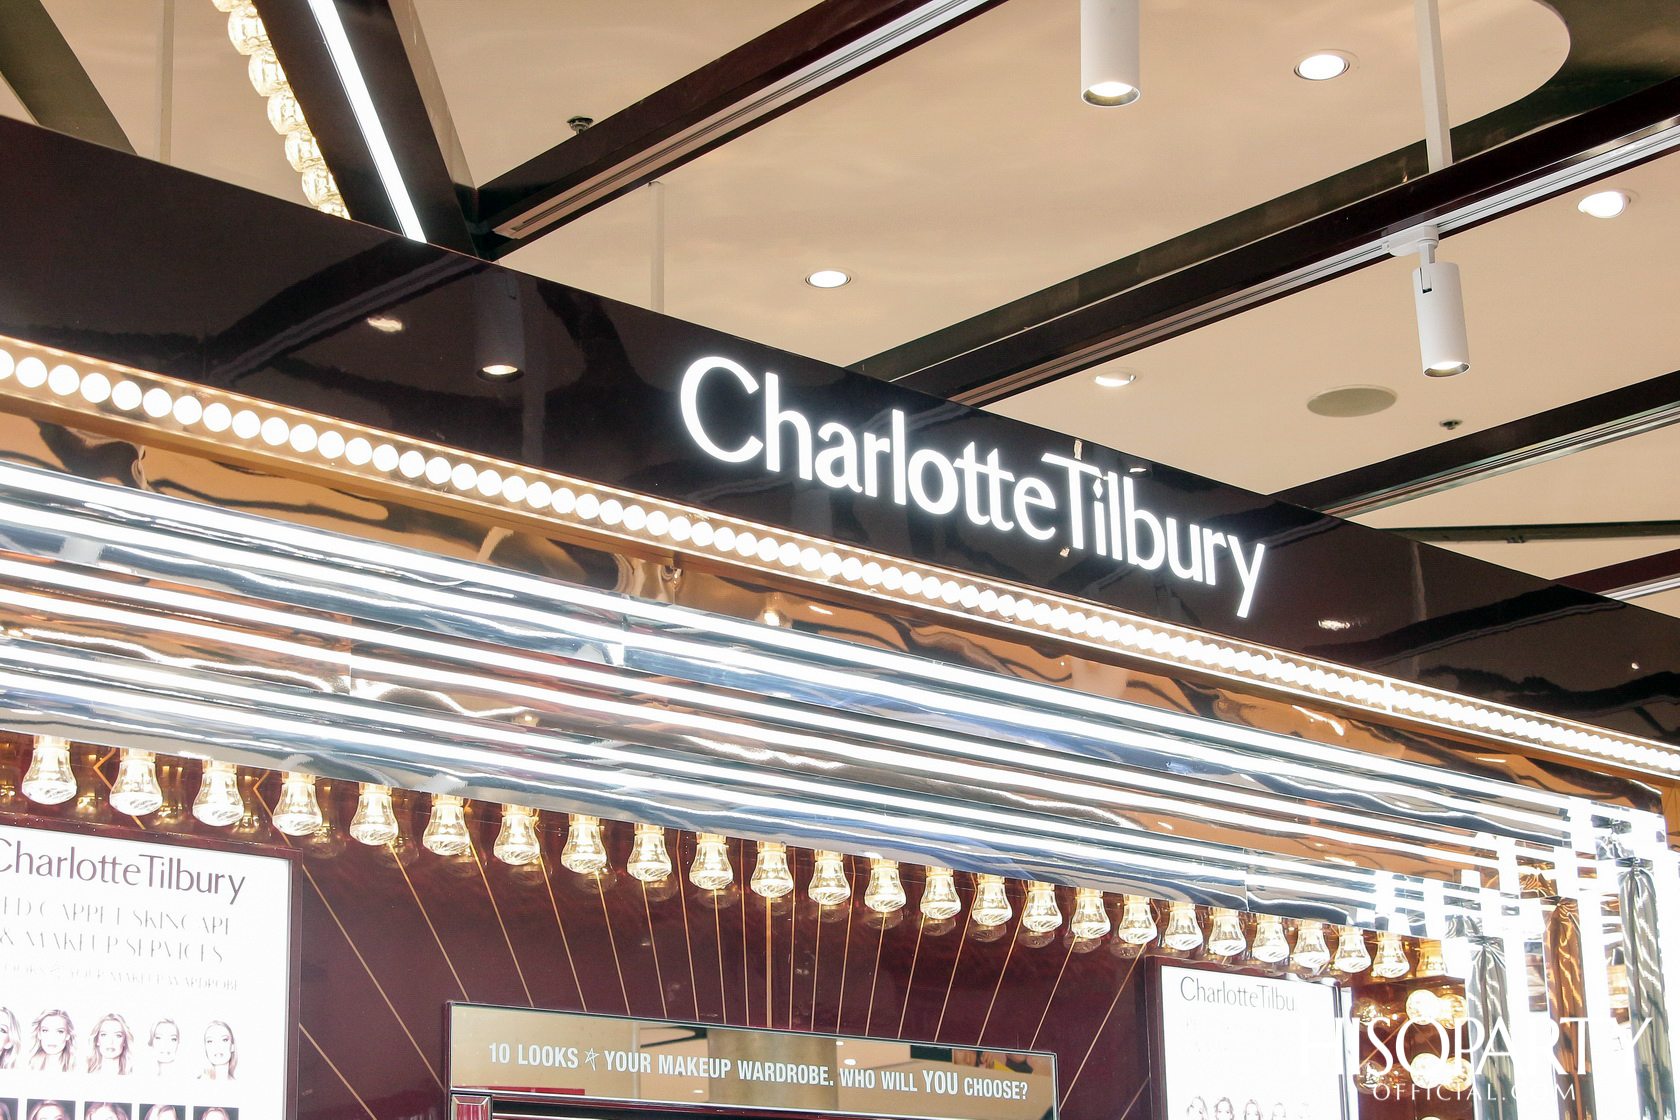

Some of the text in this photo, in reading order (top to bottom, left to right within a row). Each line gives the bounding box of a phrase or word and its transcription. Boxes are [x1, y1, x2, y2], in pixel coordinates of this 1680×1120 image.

[488, 1042, 1028, 1100] 10 LOOKS YOUR MAKEUP WARDROBE. WHO WILL YOU CHOOSE?
